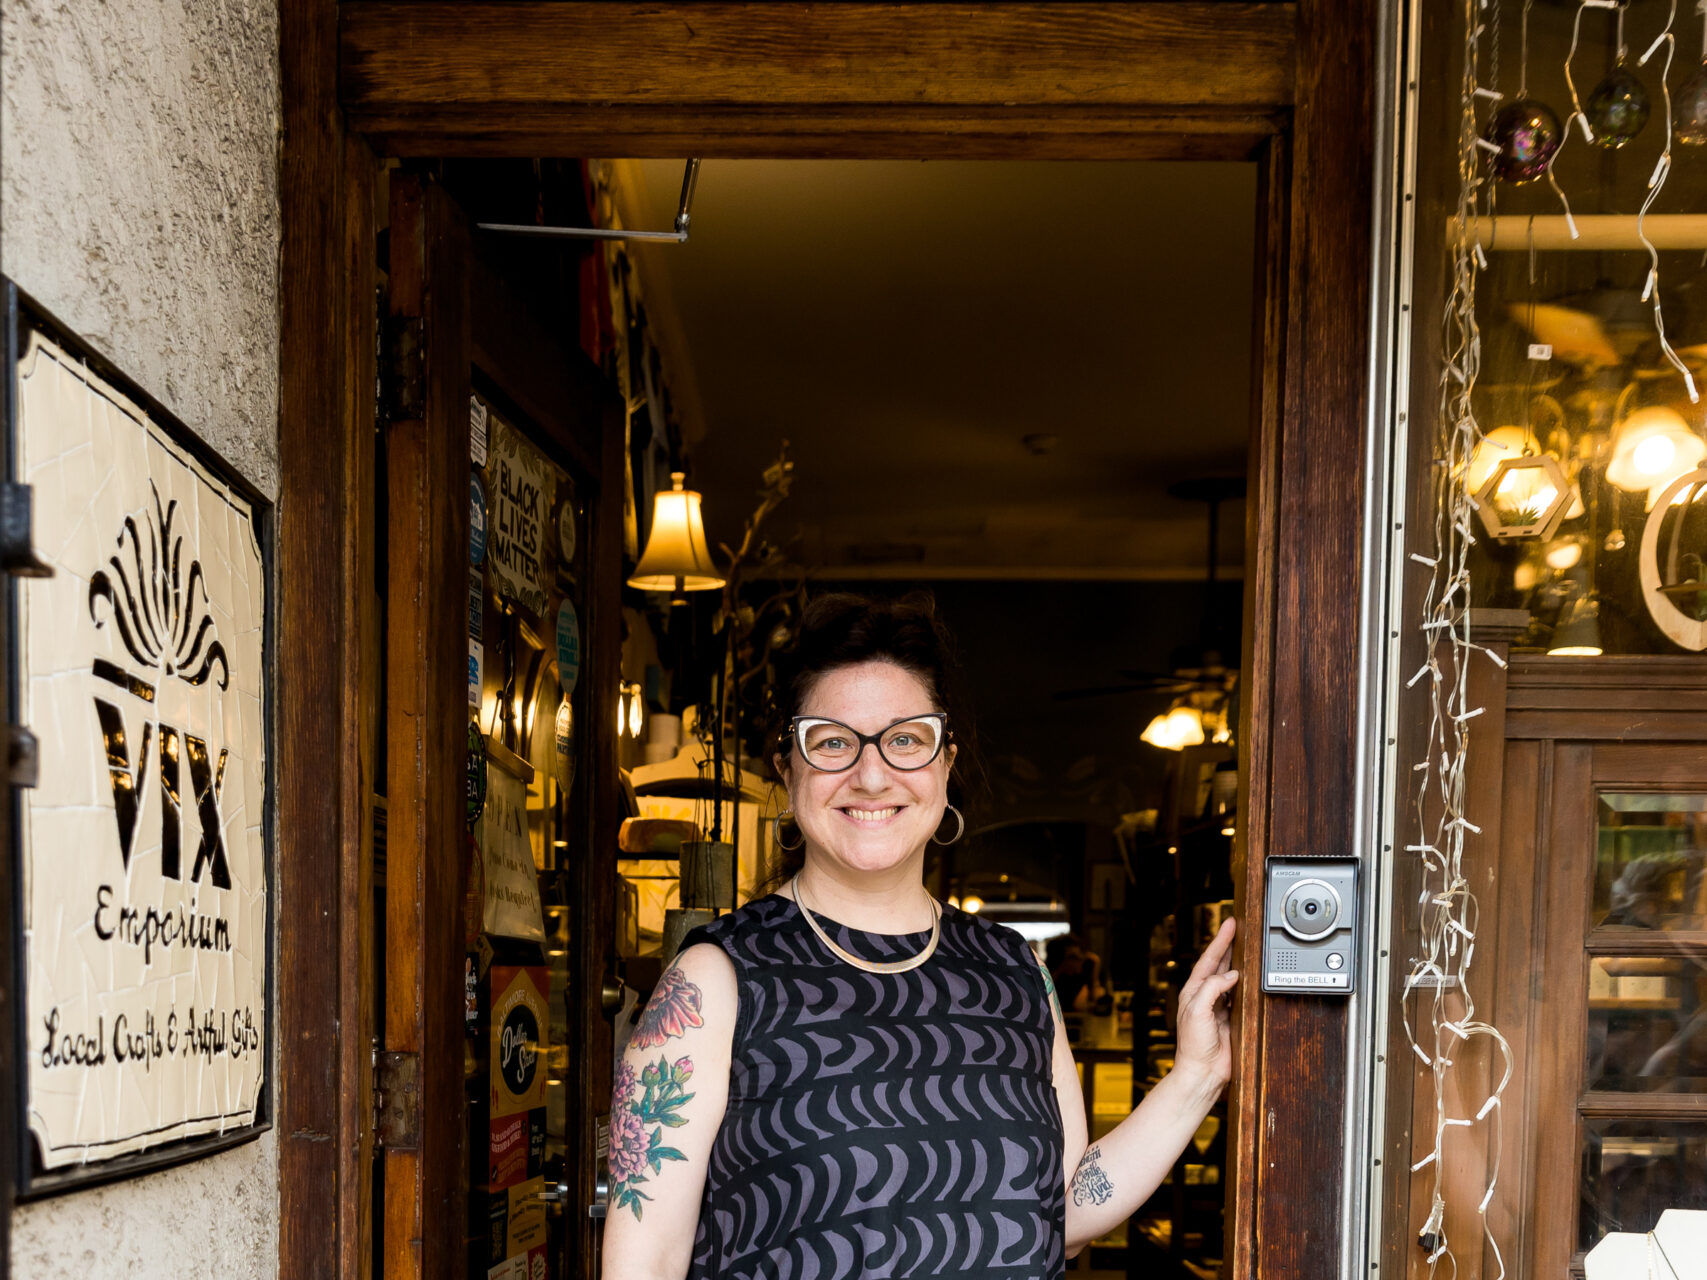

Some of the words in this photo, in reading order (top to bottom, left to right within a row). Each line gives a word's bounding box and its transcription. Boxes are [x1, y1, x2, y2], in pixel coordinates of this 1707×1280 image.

[501, 459, 539, 521] BLACK
[499, 498, 537, 554] LIVES
[495, 532, 540, 587] MATTER
[93, 696, 232, 890] VIX
[94, 884, 232, 965] Emporium
[1274, 976, 1292, 984] Ring
[1308, 976, 1328, 984] BELL
[42, 1006, 106, 1069] Local
[113, 1008, 162, 1073] Crafts
[183, 1006, 227, 1065] Artful
[231, 1005, 259, 1061] Gifts
